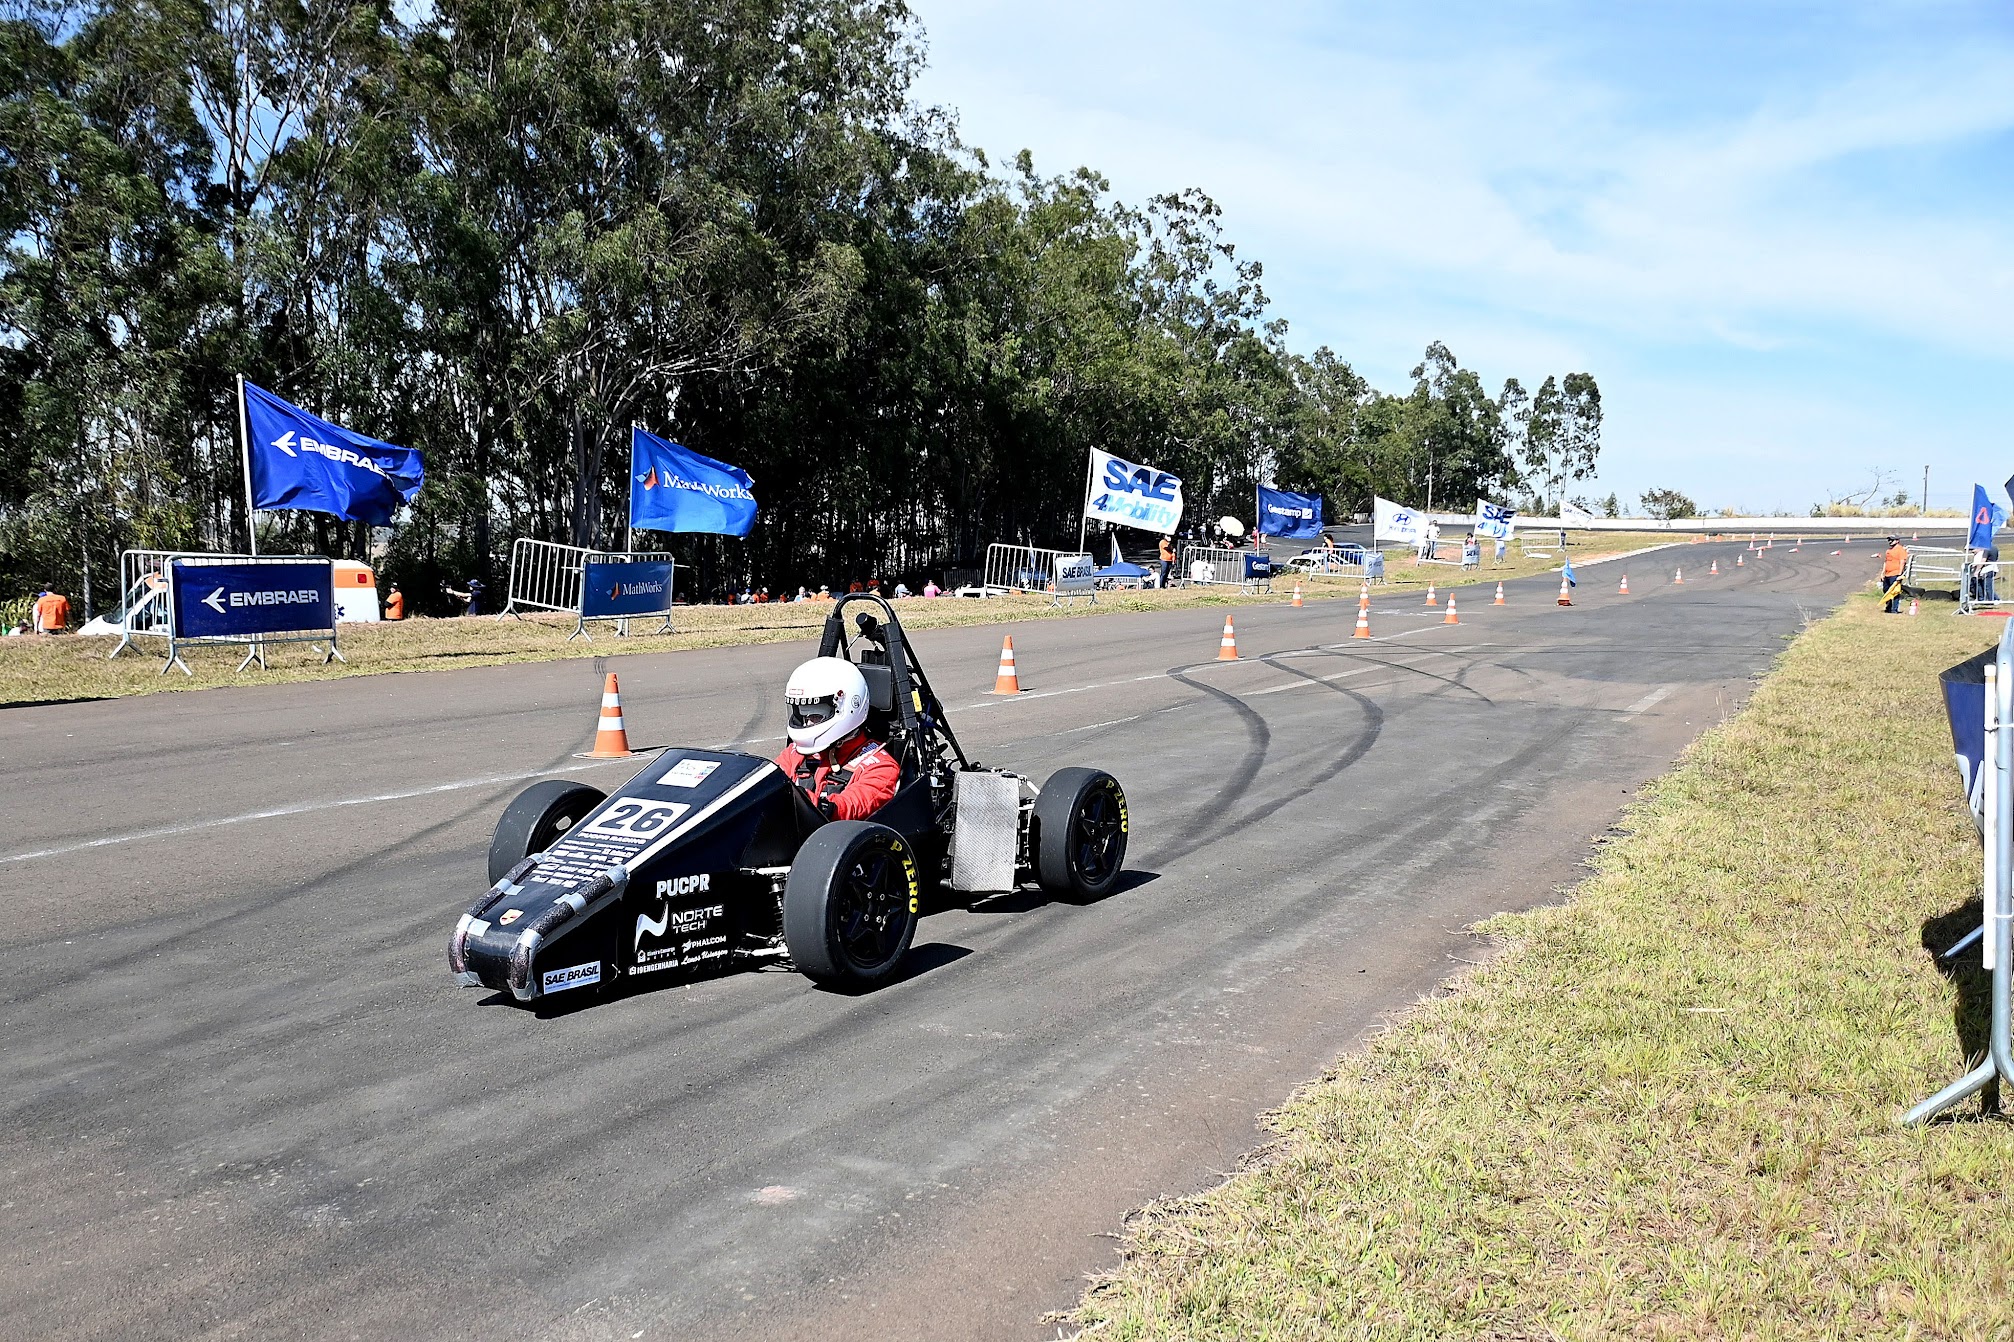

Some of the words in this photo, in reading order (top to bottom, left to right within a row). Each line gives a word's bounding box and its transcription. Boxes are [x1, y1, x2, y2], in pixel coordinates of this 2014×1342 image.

[1103, 460, 1176, 502] SAE
[1093, 494, 1177, 528] 4Mobility
[1268, 504, 1302, 518] Gestamp
[1062, 567, 1076, 578] SAE
[229, 589, 320, 607] EMBRAER
[622, 580, 663, 596] MathWorks
[597, 804, 674, 832] 26
[1114, 788, 1128, 833] ZERO
[577, 832, 611, 841] PUCPR
[609, 835, 647, 845] RACING
[656, 873, 710, 899] PUCPR
[890, 839, 903, 851] P
[902, 854, 918, 914] ZERO
[672, 905, 723, 925] NORTE
[672, 920, 706, 934] TECH
[691, 935, 727, 948] PHALCOM
[545, 973, 565, 986] SAE
[567, 965, 599, 981] BRASIL
